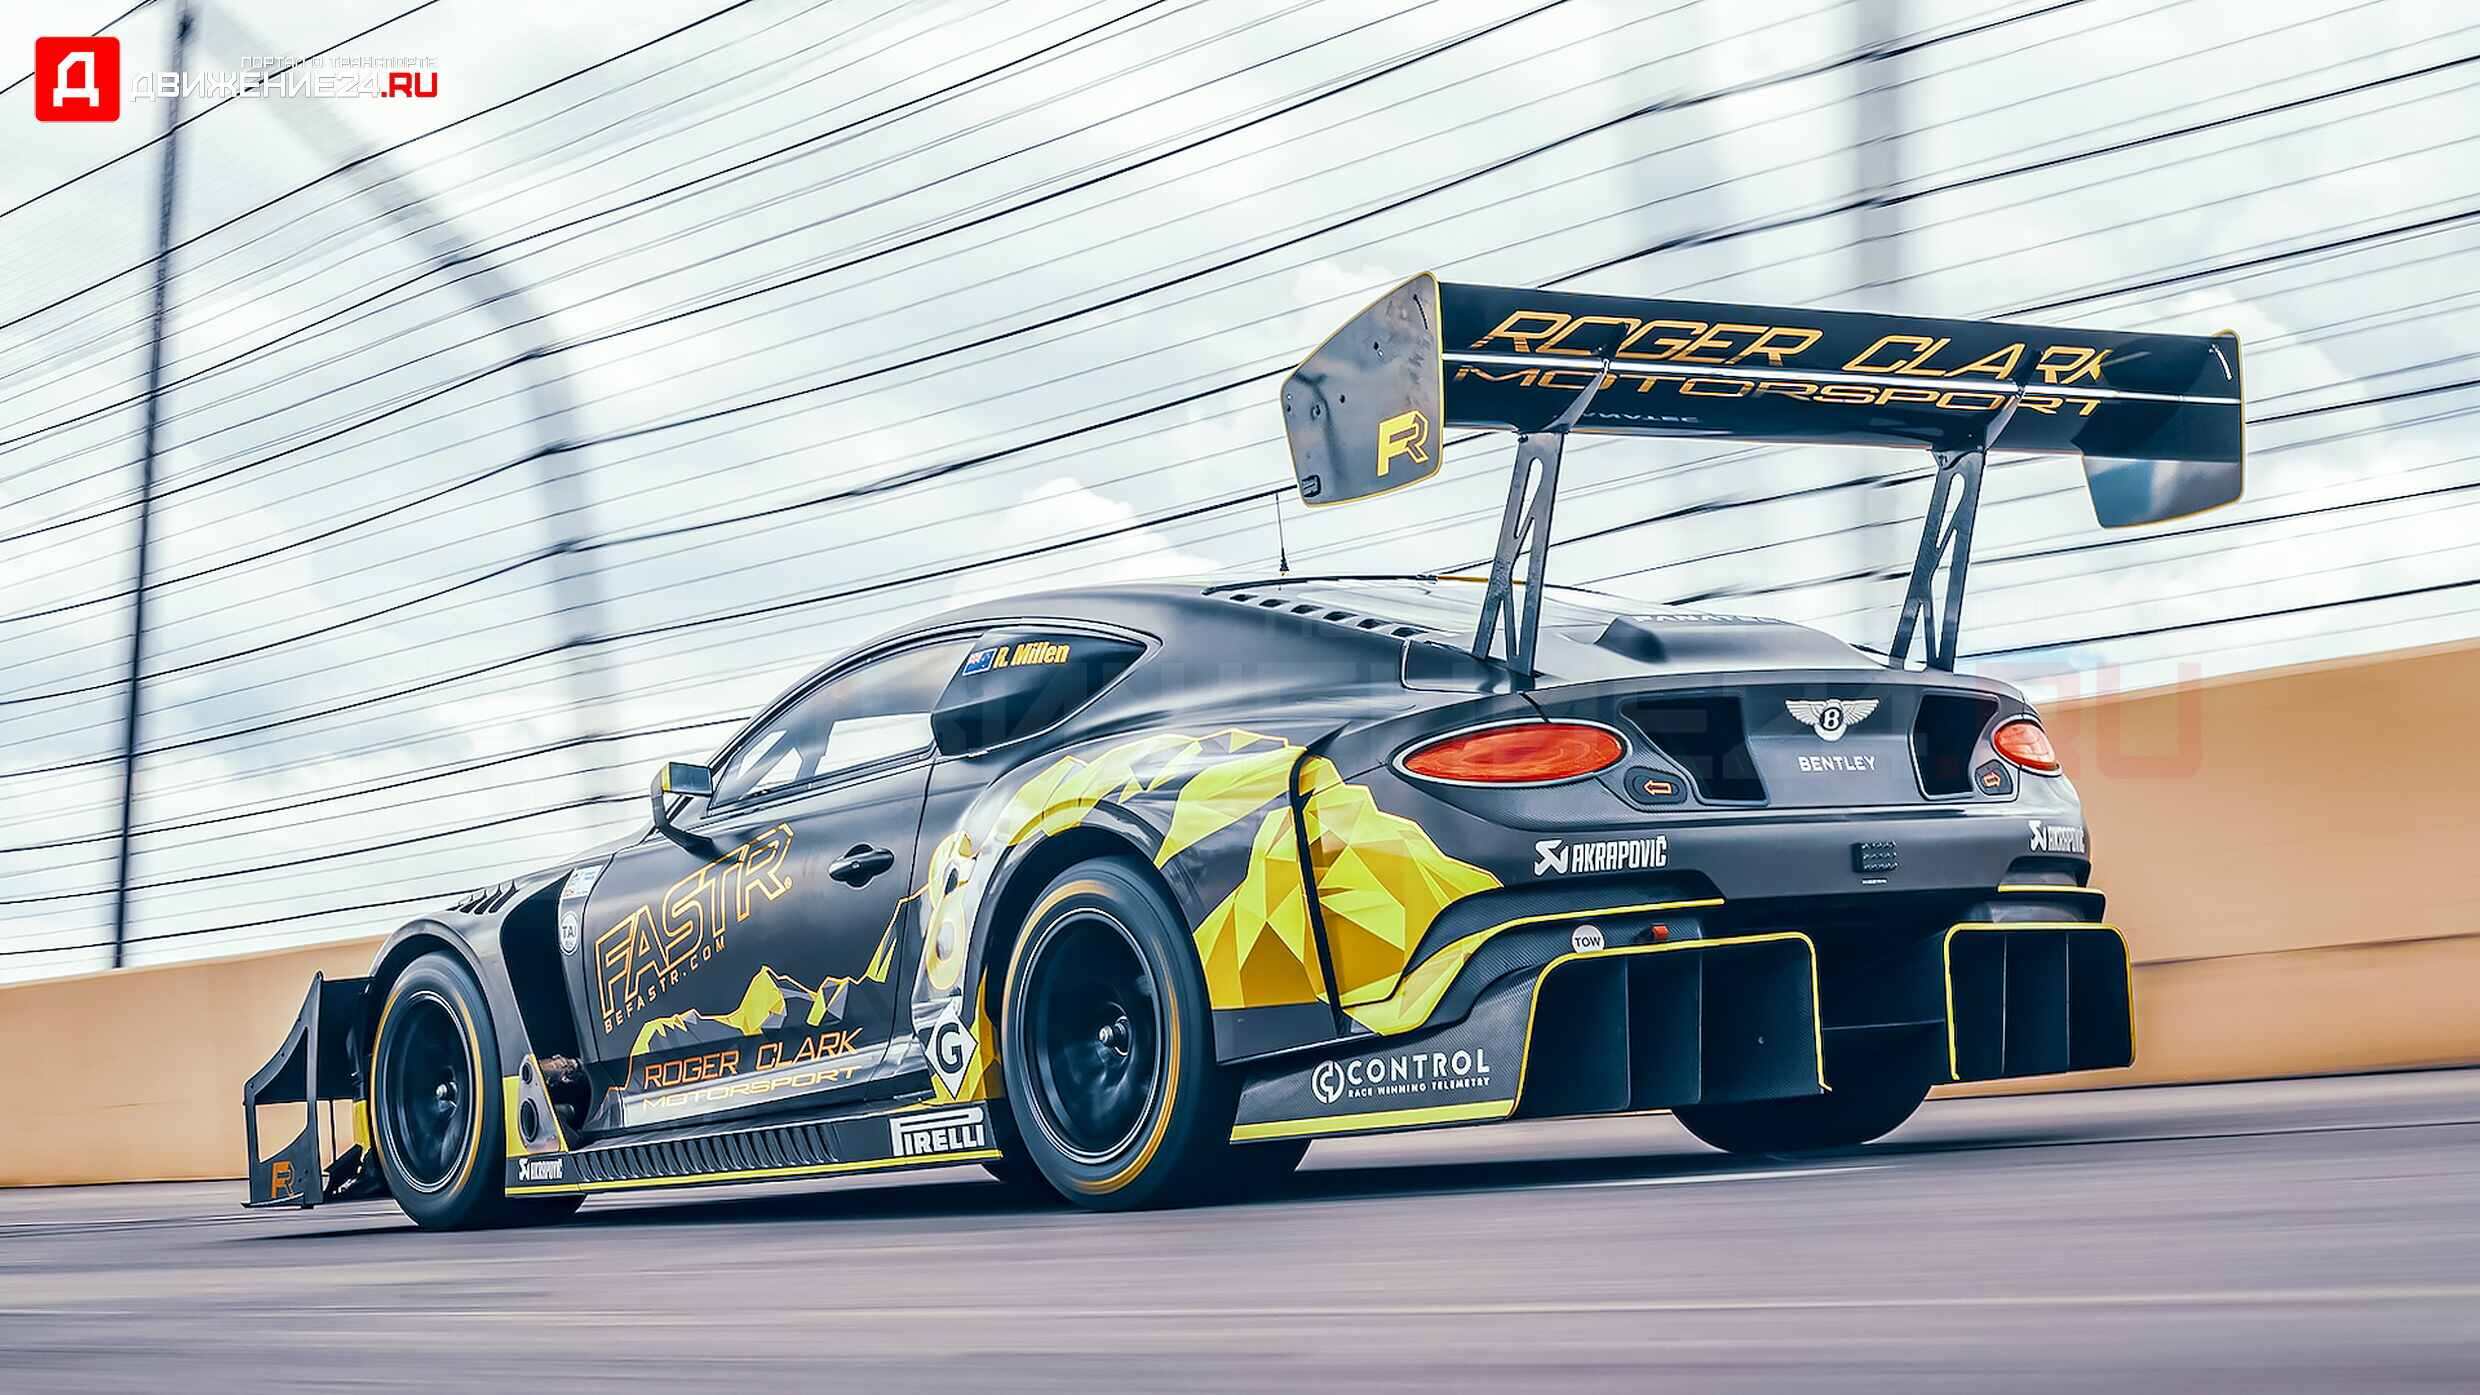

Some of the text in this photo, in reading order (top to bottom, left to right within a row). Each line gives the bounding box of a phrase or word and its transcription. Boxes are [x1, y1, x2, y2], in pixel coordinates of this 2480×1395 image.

[1470, 310, 1823, 367] ROGER
[1455, 364, 2101, 416] MOTORSPORT
[1011, 641, 1070, 666] Millen
[1797, 755, 1875, 772] BENTLEY
[1574, 936, 1601, 948] TOW
[604, 935, 726, 1035] BEFASTR.COM
[644, 1027, 863, 1090] ROGER CLARK
[935, 1022, 963, 1074] G
[1347, 1047, 1490, 1086] CONTROL
[642, 1065, 864, 1113] MOTORSPORT
[1347, 1076, 1491, 1099] RACE WINNING TELEMETRY
[889, 1106, 985, 1157] PIRELLI
